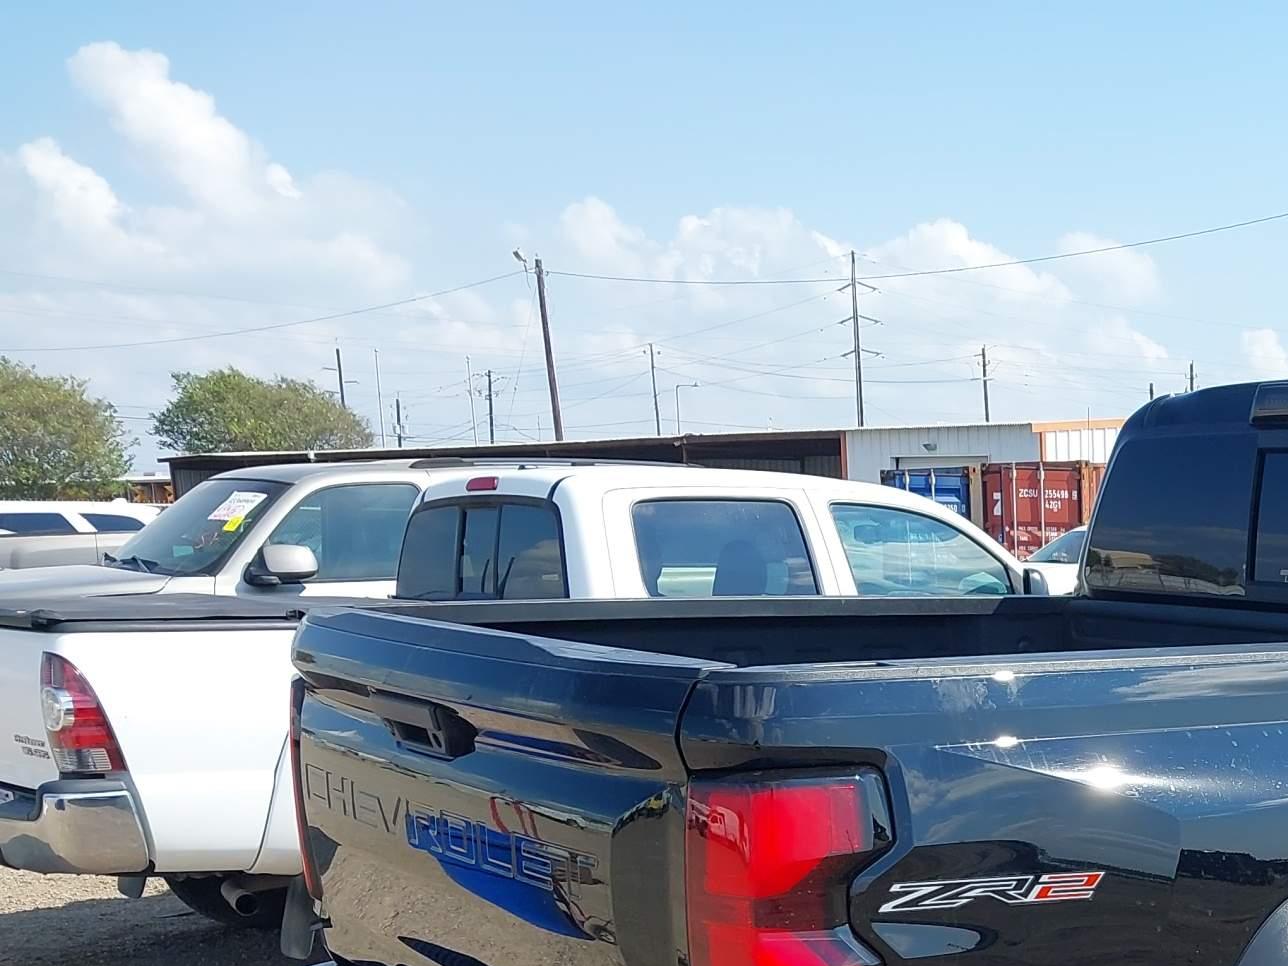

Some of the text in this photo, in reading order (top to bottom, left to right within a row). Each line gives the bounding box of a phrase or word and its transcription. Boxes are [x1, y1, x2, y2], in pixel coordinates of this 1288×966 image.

[1018, 488, 1038, 498] ZCSU
[305, 762, 600, 899] CHEVROLET
[878, 871, 1106, 913] ZR2
